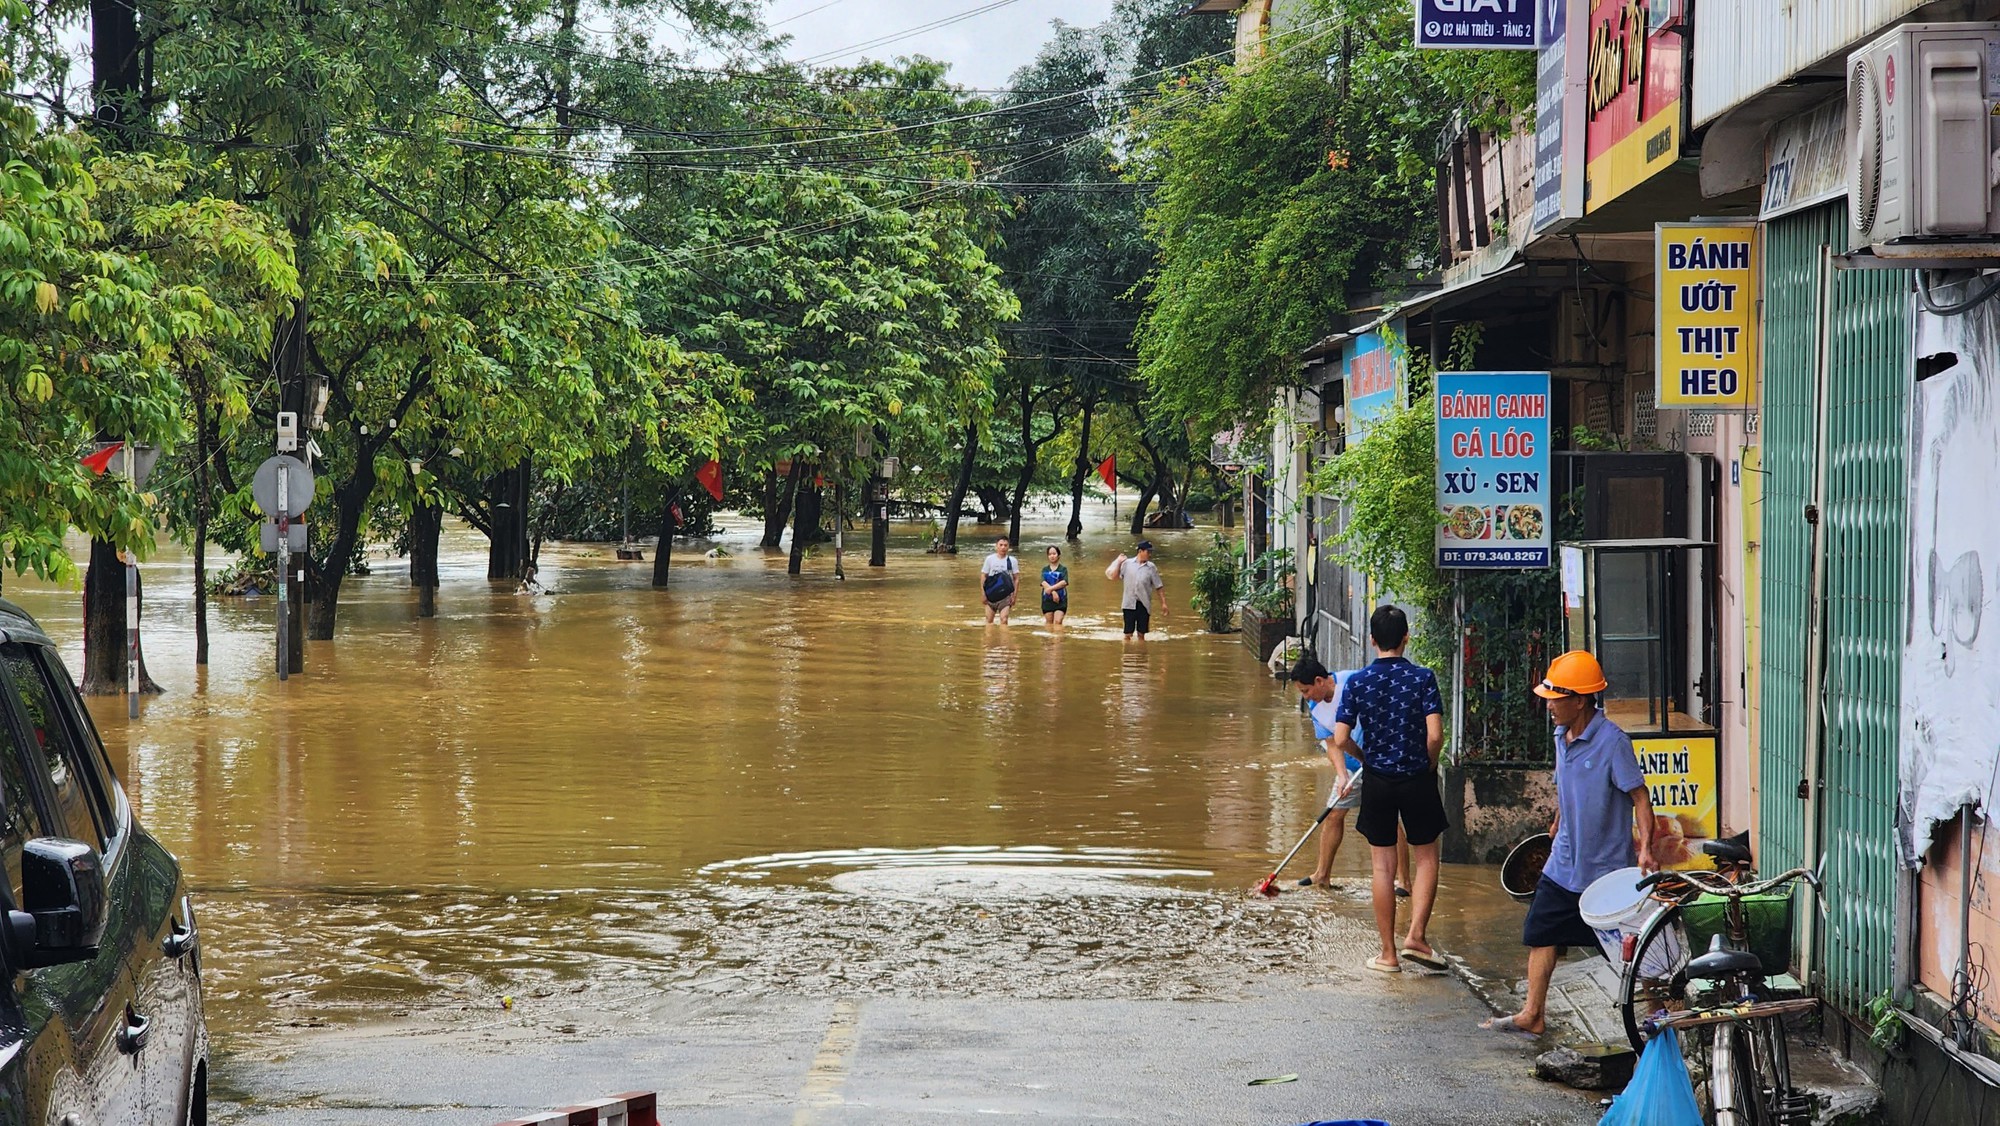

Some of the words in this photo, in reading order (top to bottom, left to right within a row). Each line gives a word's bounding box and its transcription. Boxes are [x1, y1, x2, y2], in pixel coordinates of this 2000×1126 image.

[1442, 23, 1454, 36] 02
[1455, 20, 1470, 36] HẢI
[1471, 19, 1494, 37] TRIỀU
[1502, 20, 1524, 37] TẦNG
[1525, 24, 1531, 37] 2
[1885, 114, 1895, 141] LG
[1668, 238, 1749, 270] BÁNH
[1681, 280, 1737, 312] ƯỚT
[1677, 327, 1740, 359] THỊT
[1680, 369, 1737, 396] HEO
[1441, 390, 1491, 419] BÁNH
[1496, 394, 1545, 419] CANH
[1452, 427, 1484, 458] CÁ
[1490, 427, 1534, 458] LÓC
[1444, 467, 1477, 494] XÙ
[1496, 472, 1540, 494] SEN
[1444, 551, 1461, 561] ĐT:
[1464, 551, 1543, 562] 079.340.8267
[1640, 747, 1669, 775] ÁNH
[1672, 746, 1689, 774] MÌ
[1669, 778, 1699, 806] TÂY
